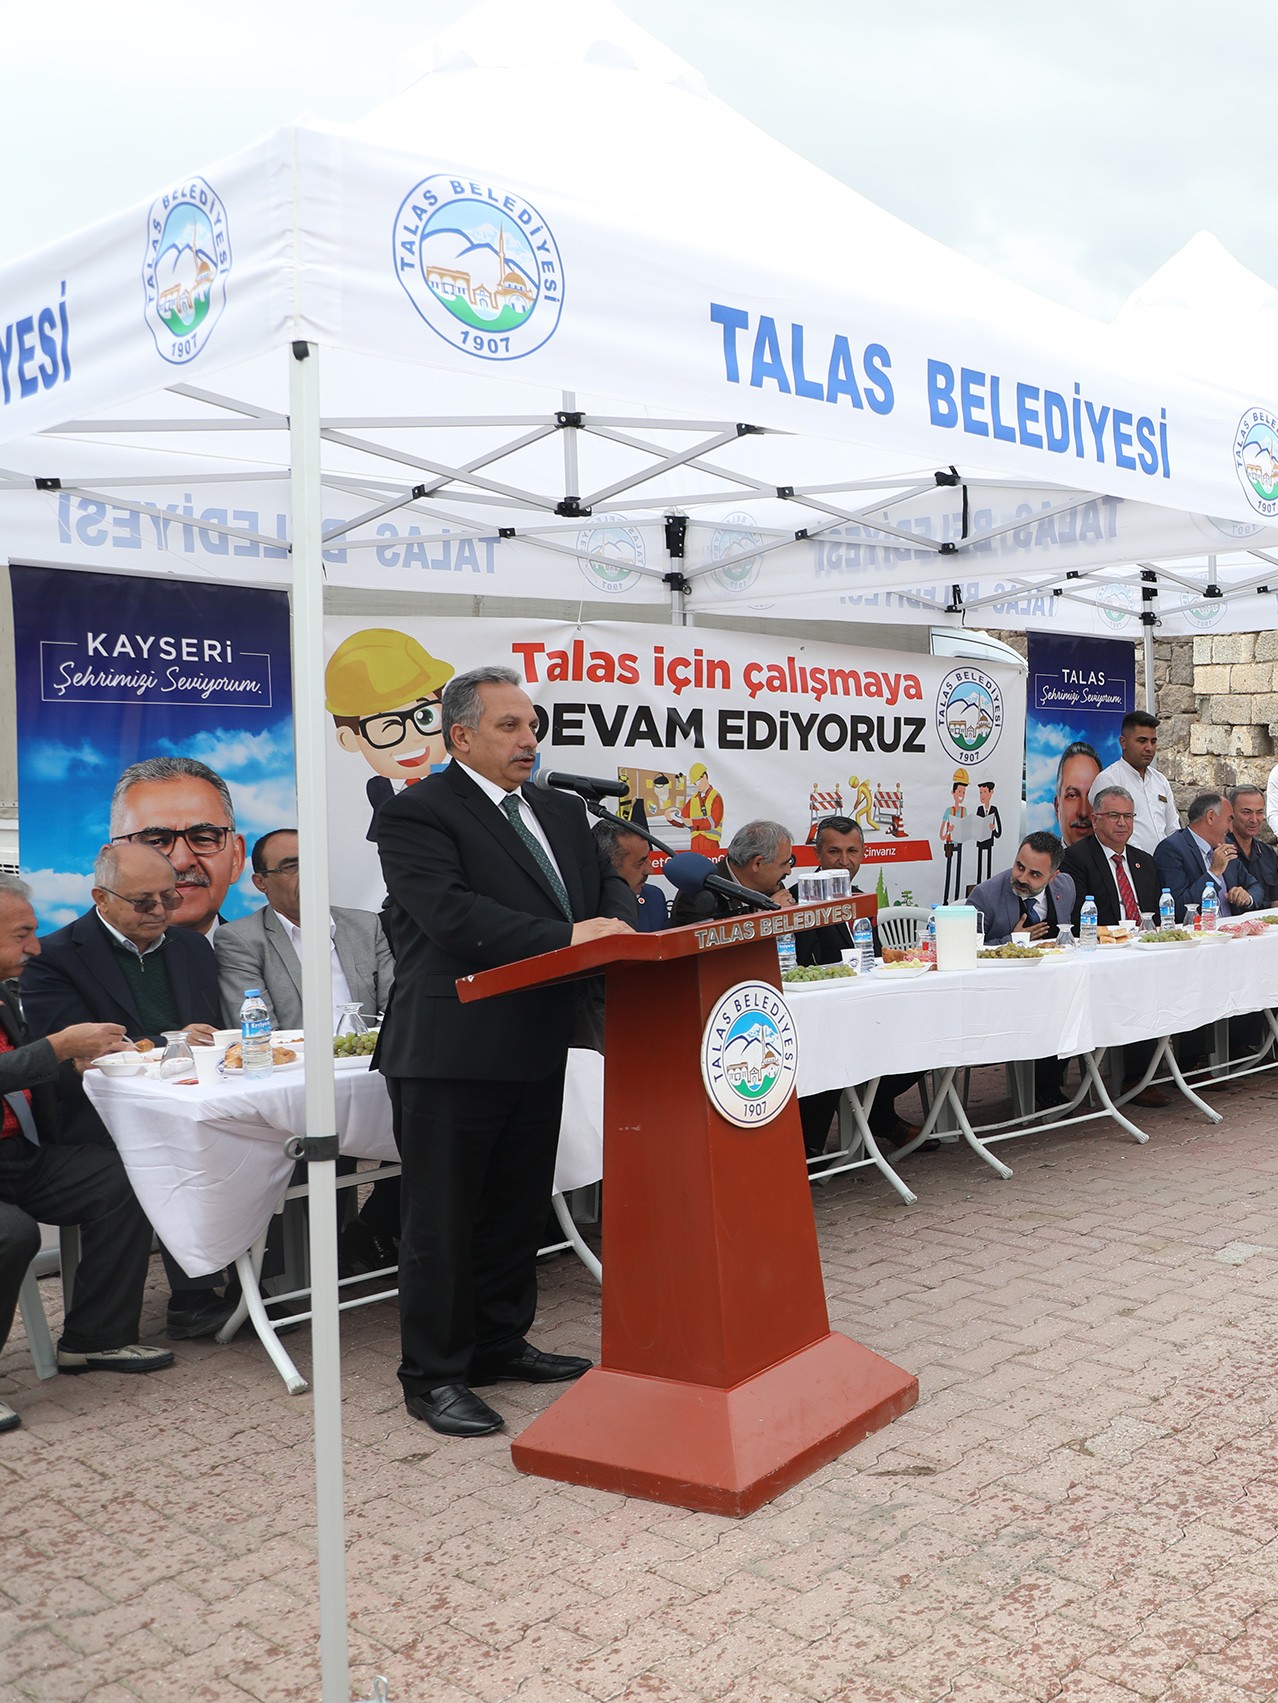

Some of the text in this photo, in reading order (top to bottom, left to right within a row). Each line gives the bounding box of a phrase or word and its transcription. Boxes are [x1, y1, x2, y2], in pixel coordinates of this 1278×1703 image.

[399, 178, 560, 304] TALAS BELEDİYESİ
[146, 217, 163, 307] TALAS
[171, 333, 198, 359] 1907
[459, 330, 512, 355] 1907
[710, 302, 1171, 480] TALAS BELEDİYESİ
[1235, 419, 1250, 469] TALAS
[1257, 500, 1277, 513] 1907
[53, 661, 158, 696] Şehrimizi
[511, 640, 924, 707] Talas için çalışmaya
[1061, 668, 1106, 686] TALAS
[937, 671, 1001, 728] TALAS BELEDİYESİ
[959, 751, 980, 763] 1907
[695, 920, 755, 950] TALAS
[711, 993, 794, 1083] TALAS BELEDİYESİ
[743, 1101, 767, 1117] 1907
